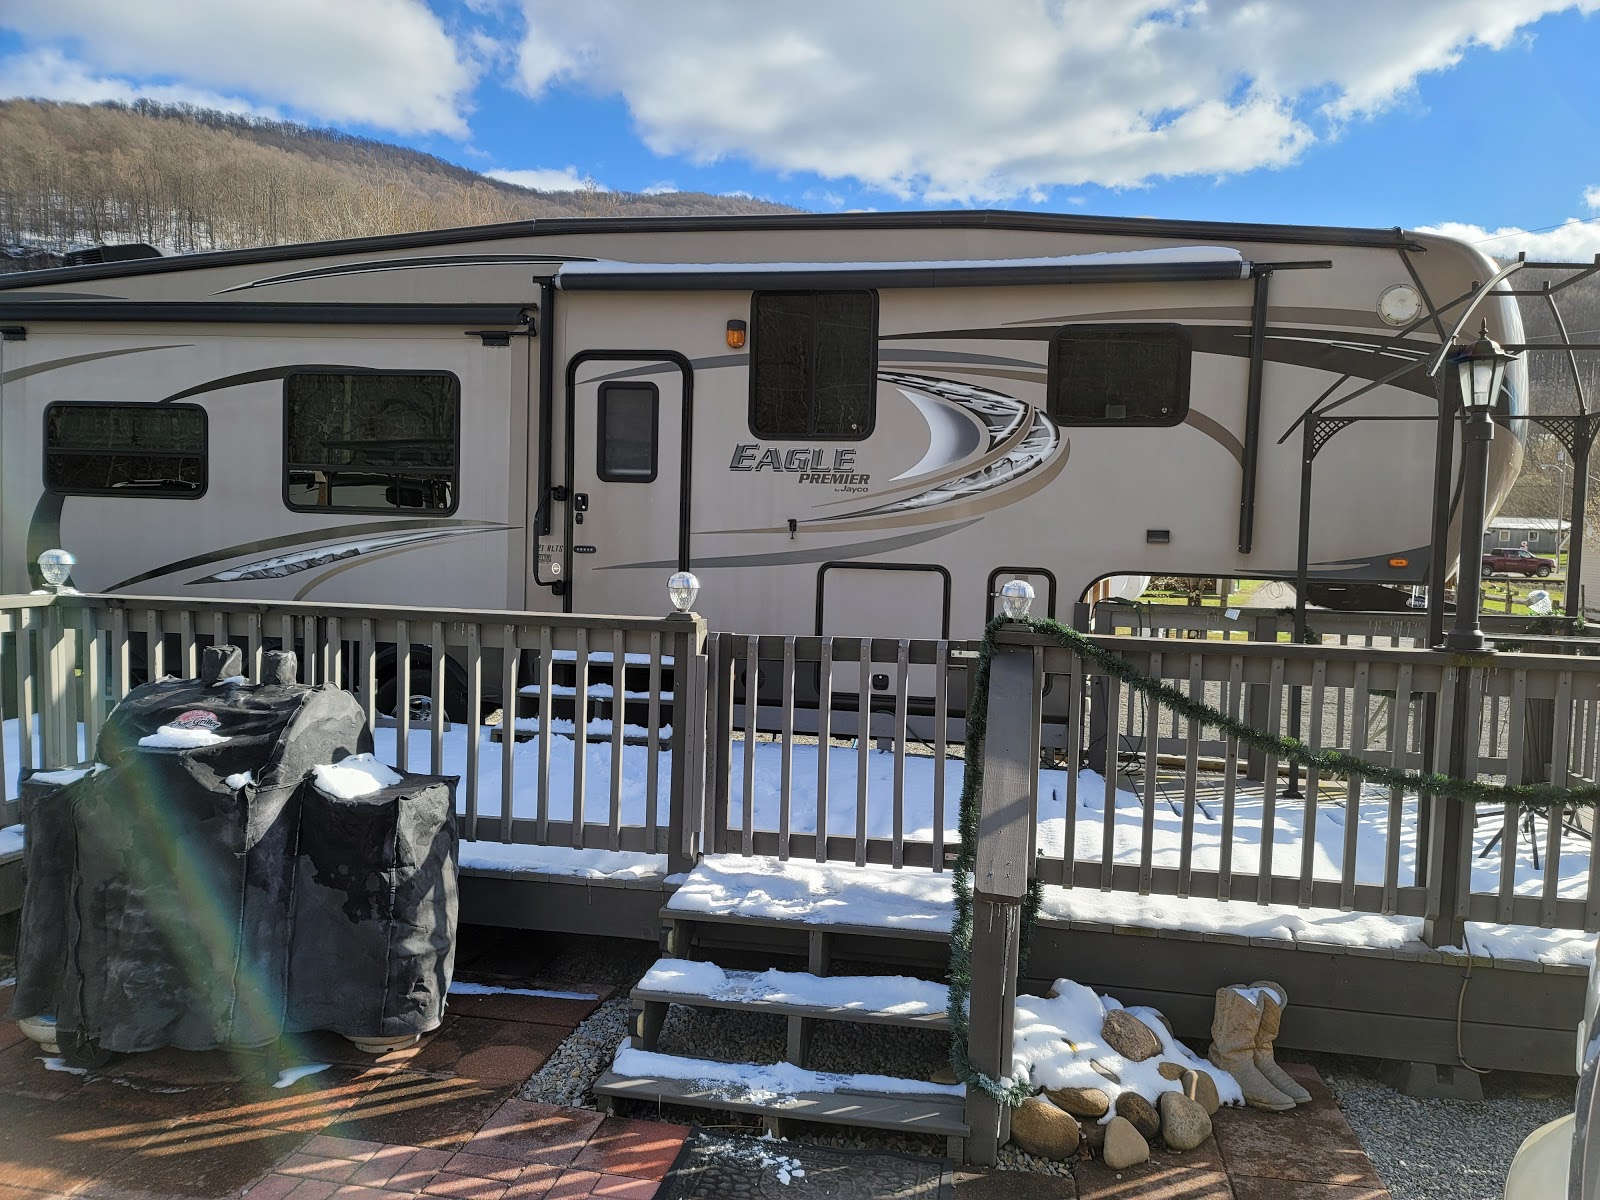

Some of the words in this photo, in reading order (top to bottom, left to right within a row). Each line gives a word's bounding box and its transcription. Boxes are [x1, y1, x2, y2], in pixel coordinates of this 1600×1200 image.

[729, 443, 856, 473] EAGLE
[798, 473, 870, 485] PREMIER
[840, 485, 869, 493] Jayco
[547, 544, 563, 552] RLTS
